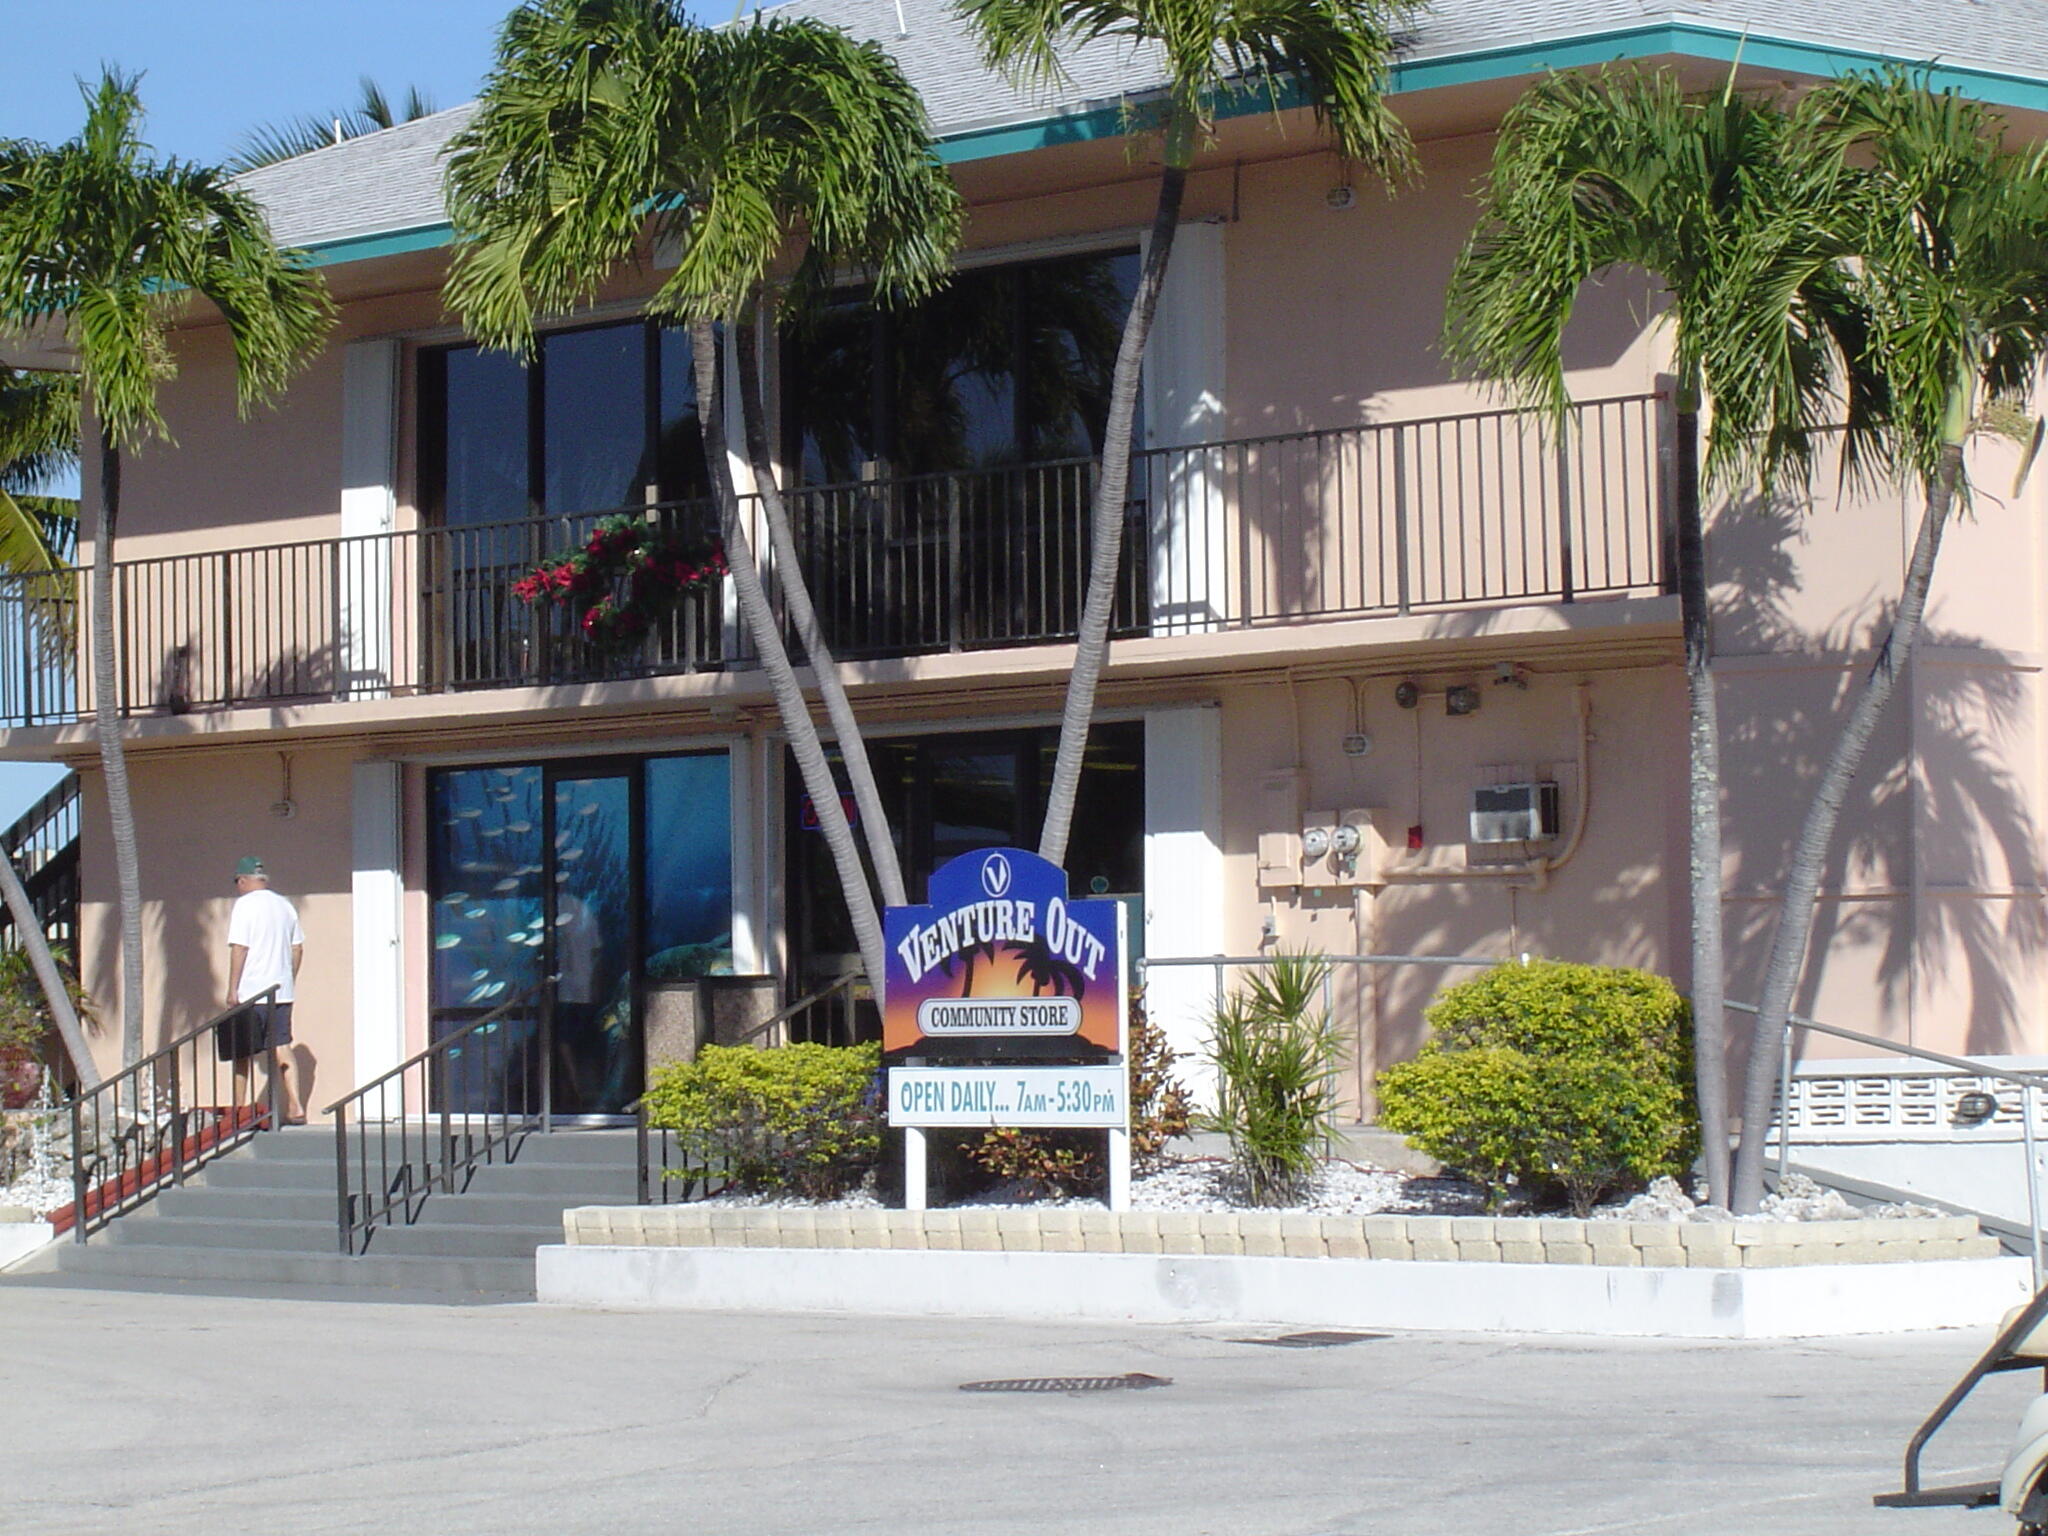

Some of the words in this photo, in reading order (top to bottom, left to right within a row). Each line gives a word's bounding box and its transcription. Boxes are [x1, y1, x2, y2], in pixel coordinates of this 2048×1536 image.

[897, 899, 1035, 984] VENTURE
[1046, 896, 1106, 981] OUT
[931, 1006, 1016, 1028] COMMUNITY
[1020, 1005, 1068, 1026] STORE
[901, 1081, 945, 1112] OPEN
[951, 1081, 1010, 1112] DAILY...
